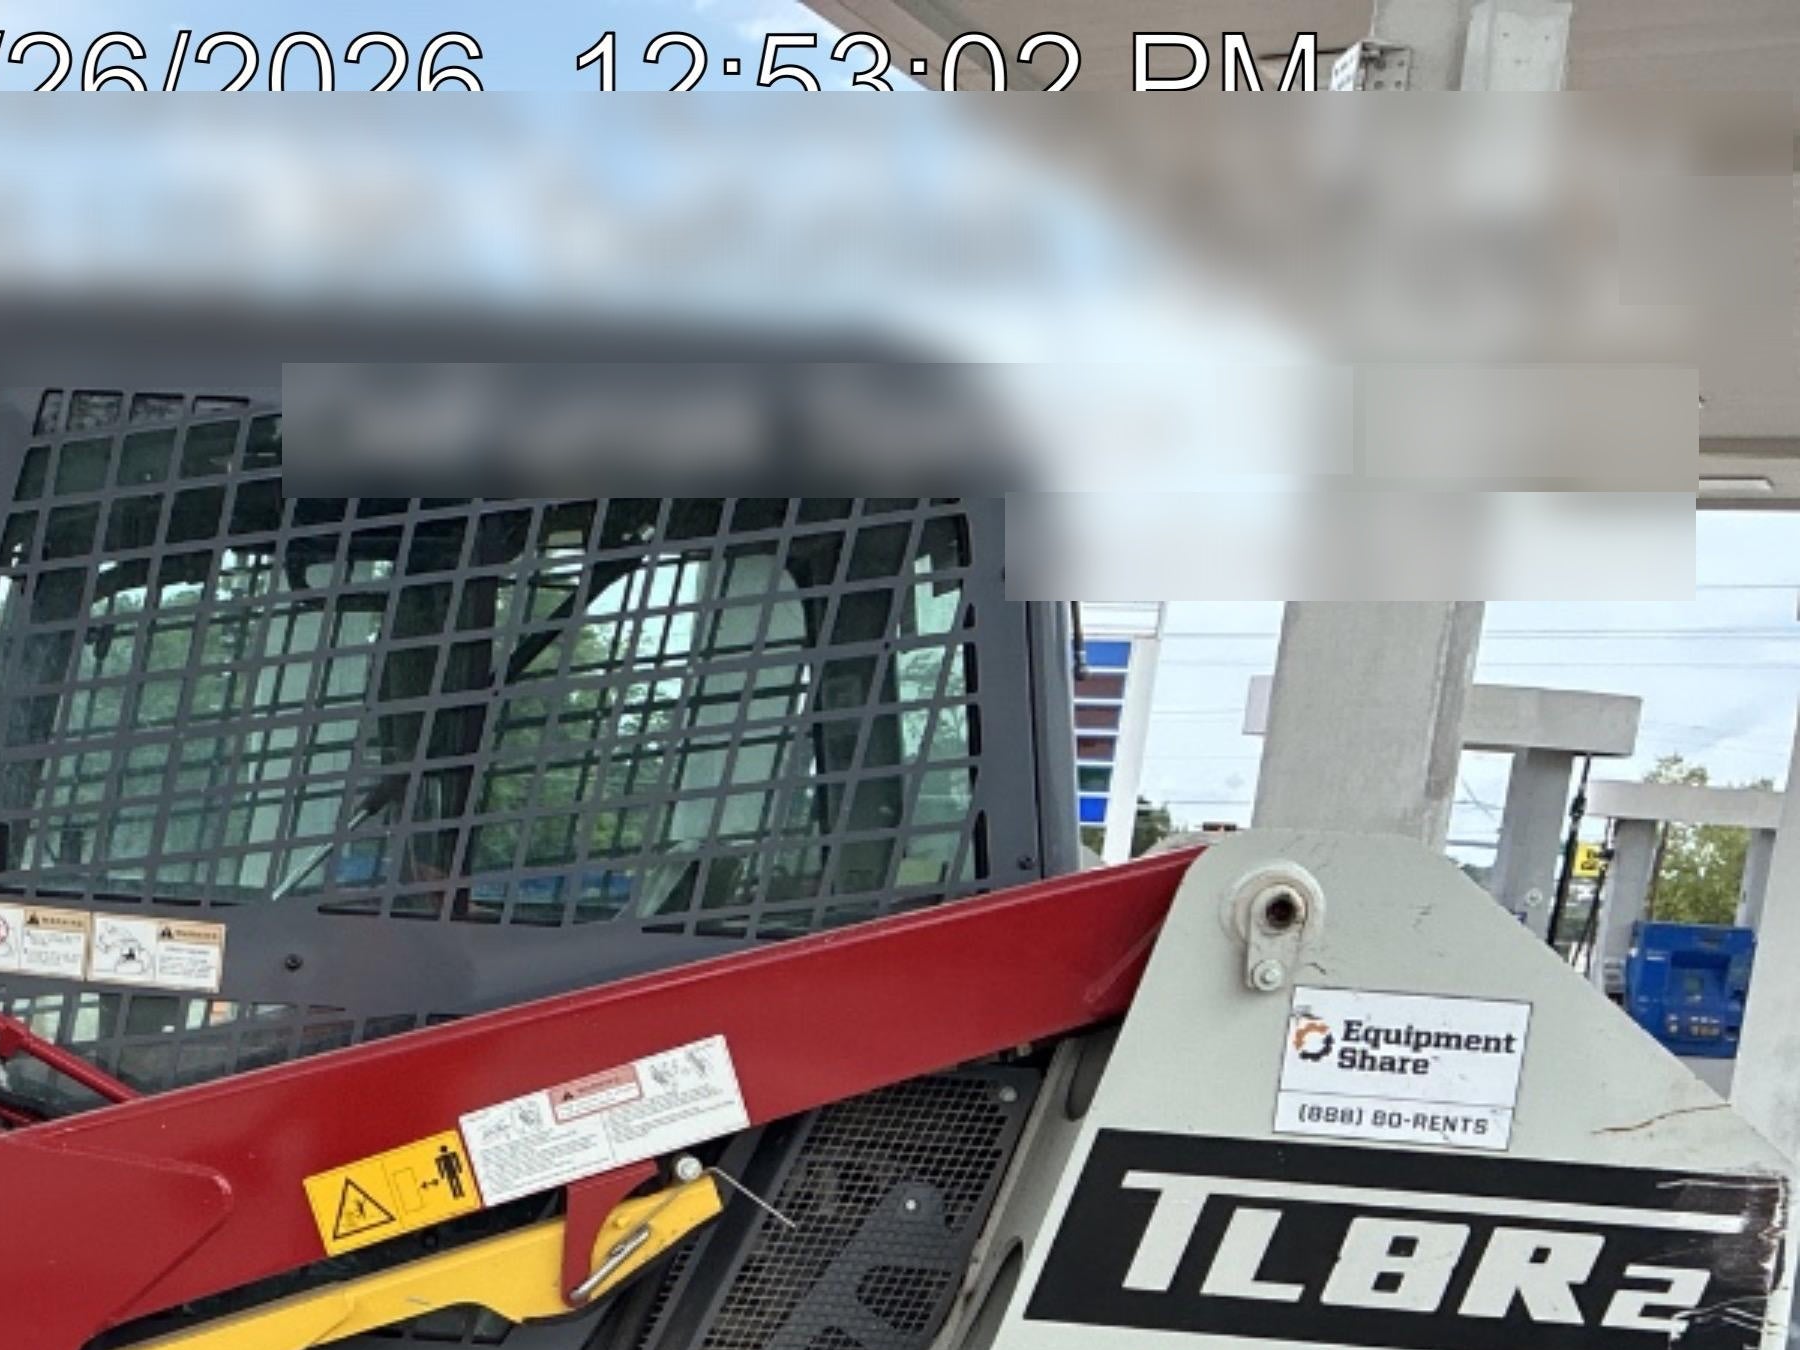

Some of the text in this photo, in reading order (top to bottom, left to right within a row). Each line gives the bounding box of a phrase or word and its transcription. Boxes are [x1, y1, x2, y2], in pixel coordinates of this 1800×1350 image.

[1341, 1018, 1518, 1055] Equipment
[1337, 1047, 1430, 1075] Share
[1298, 1103, 1363, 1126] (888)
